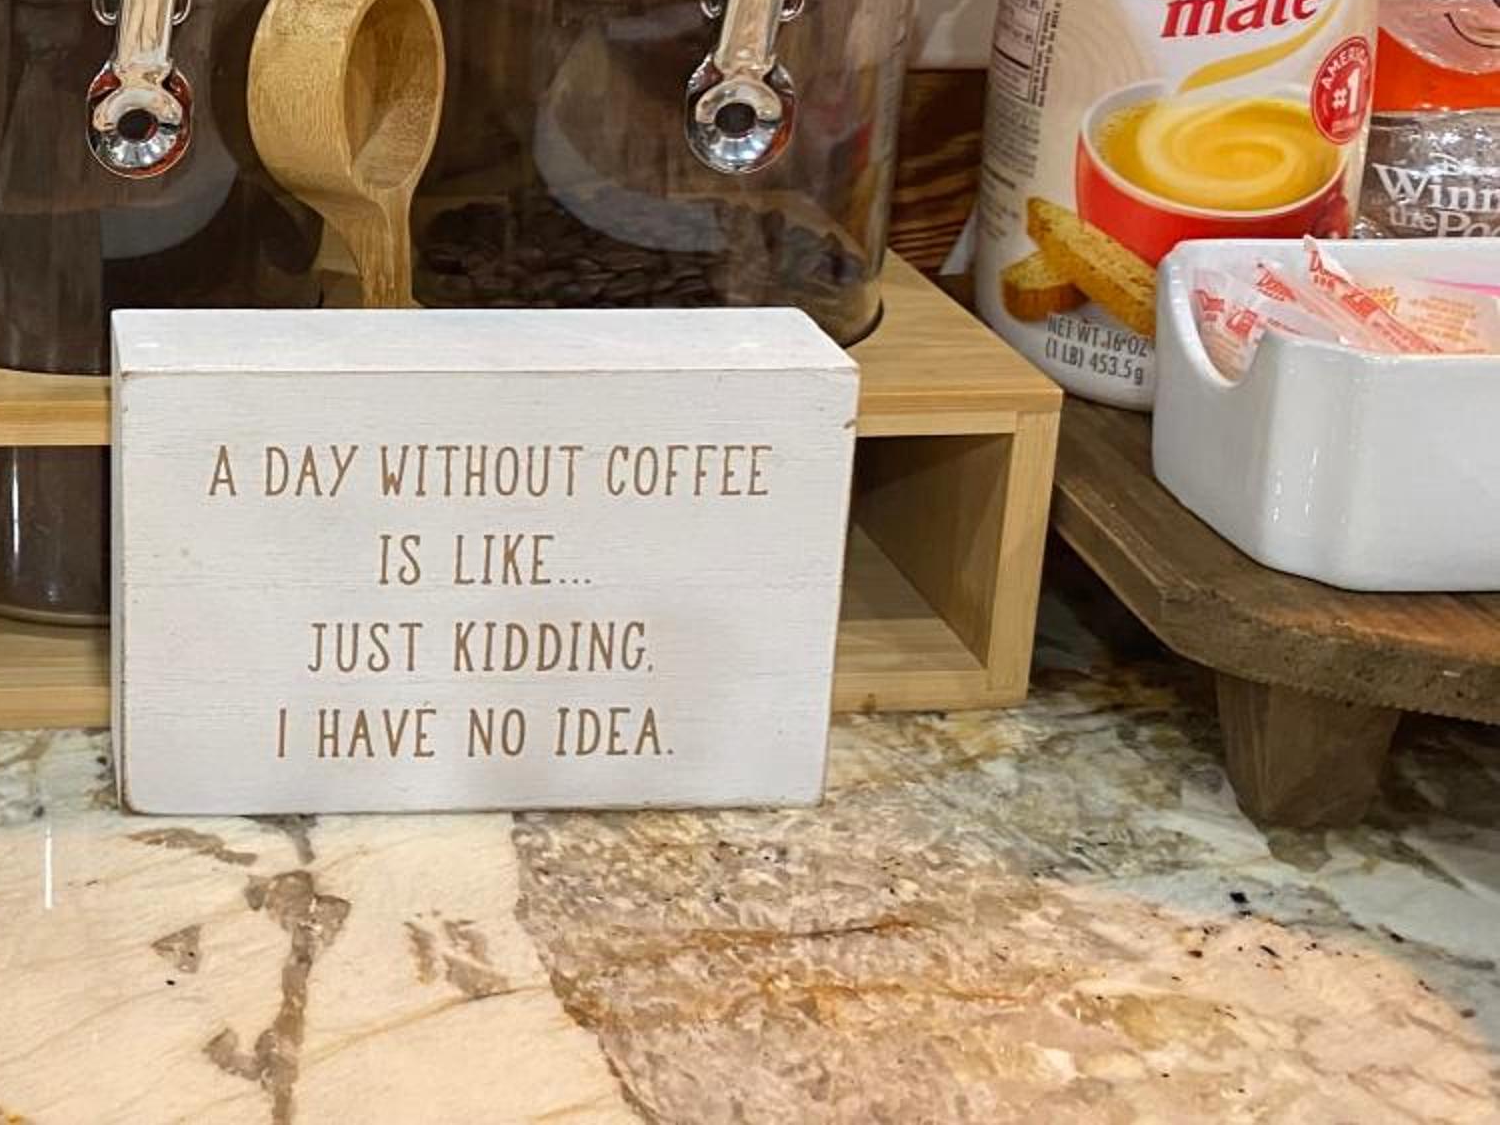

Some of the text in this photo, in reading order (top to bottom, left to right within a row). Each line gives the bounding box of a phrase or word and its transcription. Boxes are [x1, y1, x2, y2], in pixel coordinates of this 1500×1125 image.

[1332, 67, 1361, 114] #1
[1047, 315, 1073, 339] NET
[1061, 343, 1084, 369] LB)
[208, 445, 773, 497] A DAY WITHOUT COFFEE
[377, 534, 592, 585] IS LIKE...
[307, 622, 423, 672] JUST
[277, 707, 675, 758] I HAVE NO IDEA.
